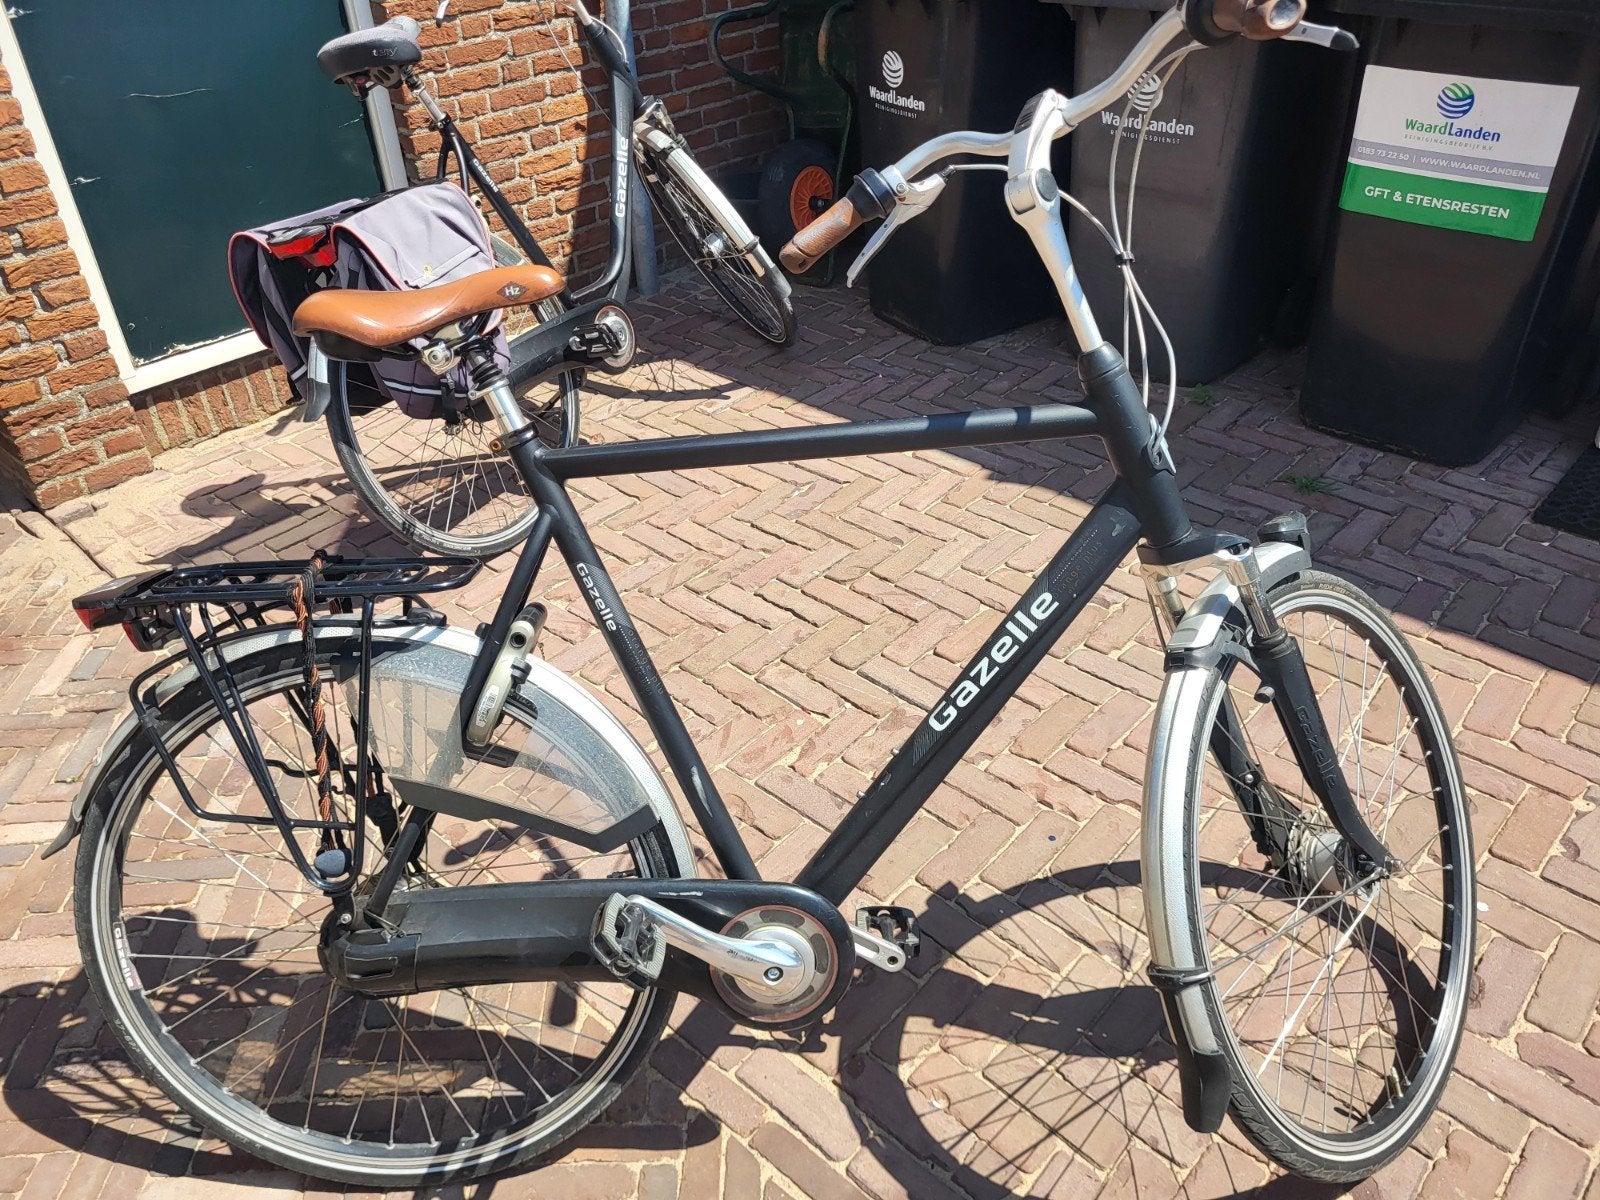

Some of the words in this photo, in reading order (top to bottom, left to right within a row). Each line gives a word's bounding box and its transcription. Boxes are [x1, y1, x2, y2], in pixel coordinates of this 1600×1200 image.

[869, 85, 925, 111] WaardLanden
[1404, 118, 1501, 143] WaardLanden
[615, 136, 629, 217] Gazelle
[1357, 146, 1375, 155] 0183
[1376, 149, 1386, 157] 73
[1387, 151, 1397, 159] 22
[1398, 153, 1410, 161] 50
[1420, 156, 1541, 180] WWW.WAARDLANDEN.NL
[1364, 185, 1391, 199] GFT
[1393, 191, 1403, 202] &
[1405, 193, 1511, 219] ETENSRESTEN
[576, 562, 617, 632] Gazelle
[928, 591, 1060, 732] Gazelle
[1297, 705, 1338, 791] Gazelle
